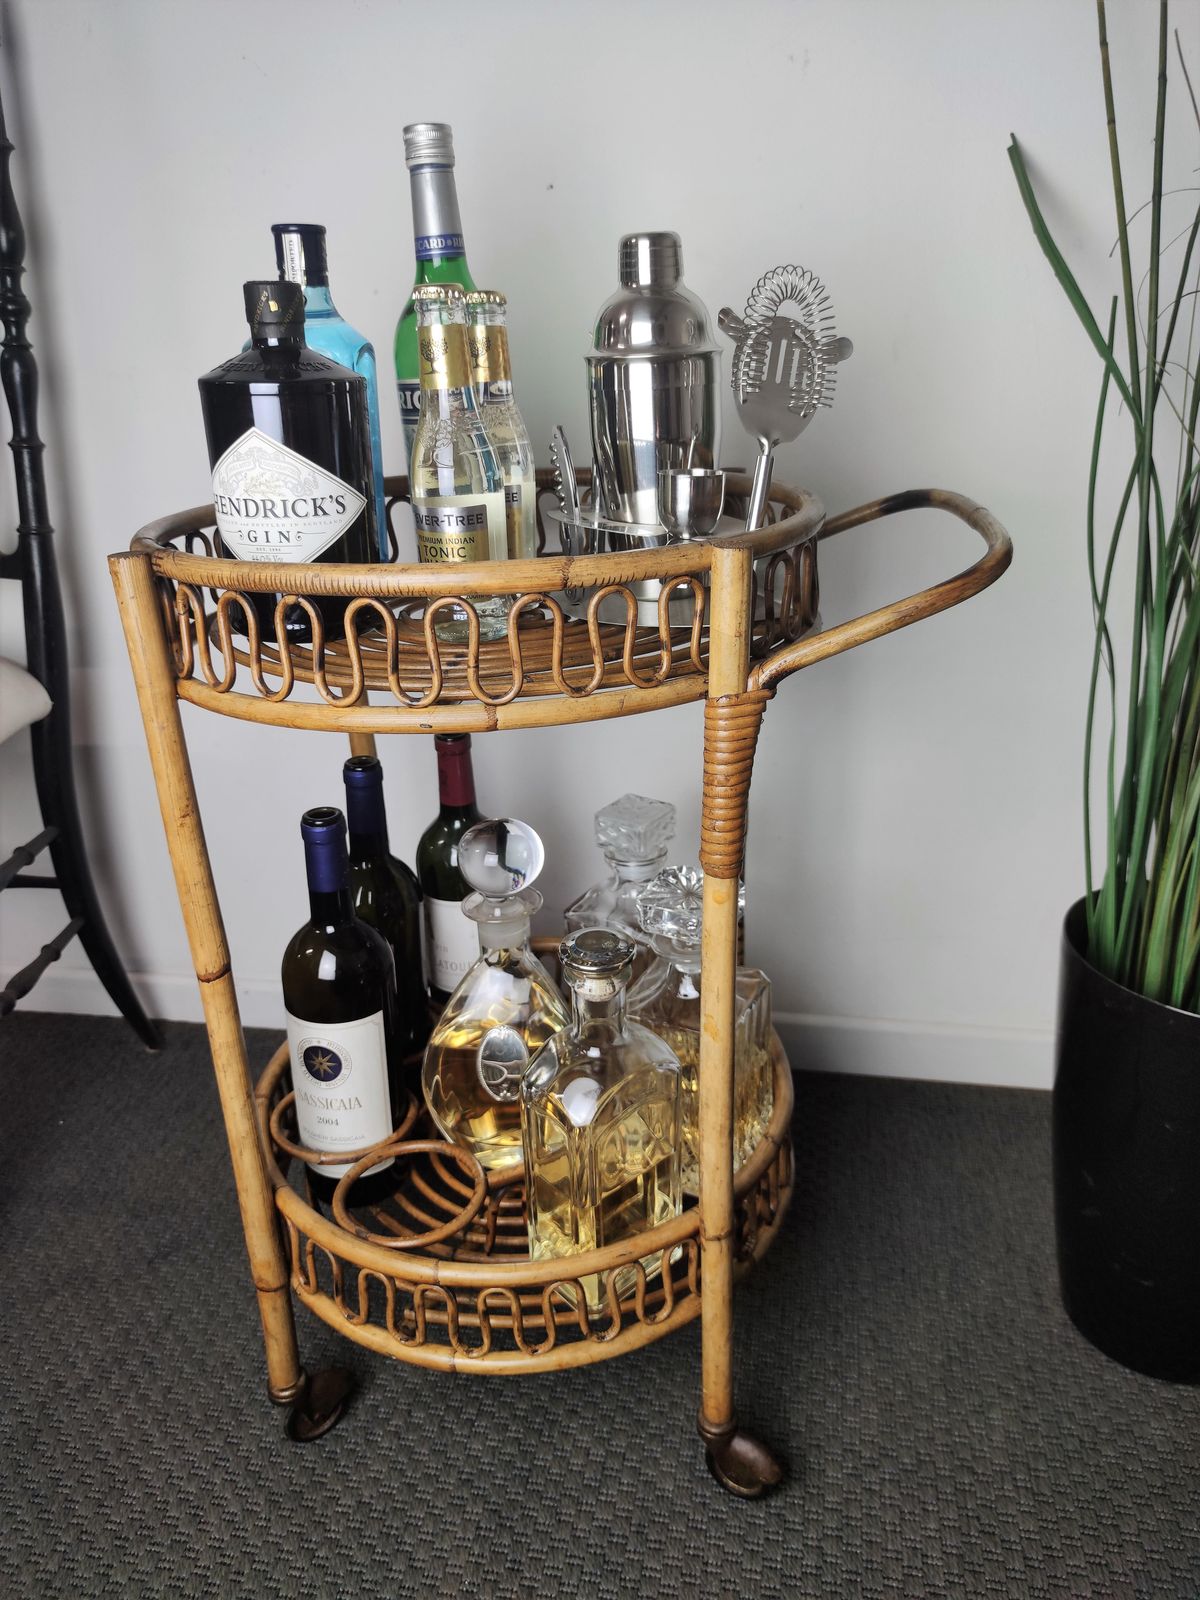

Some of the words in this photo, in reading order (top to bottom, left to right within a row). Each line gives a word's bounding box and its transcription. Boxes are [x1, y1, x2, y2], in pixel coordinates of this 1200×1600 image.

[415, 513, 484, 527] EVER-TREE
[247, 530, 291, 543] GIN
[445, 537, 475, 545] INDIAN
[424, 545, 467, 558] TONIC
[317, 1116, 339, 1126] 2004
